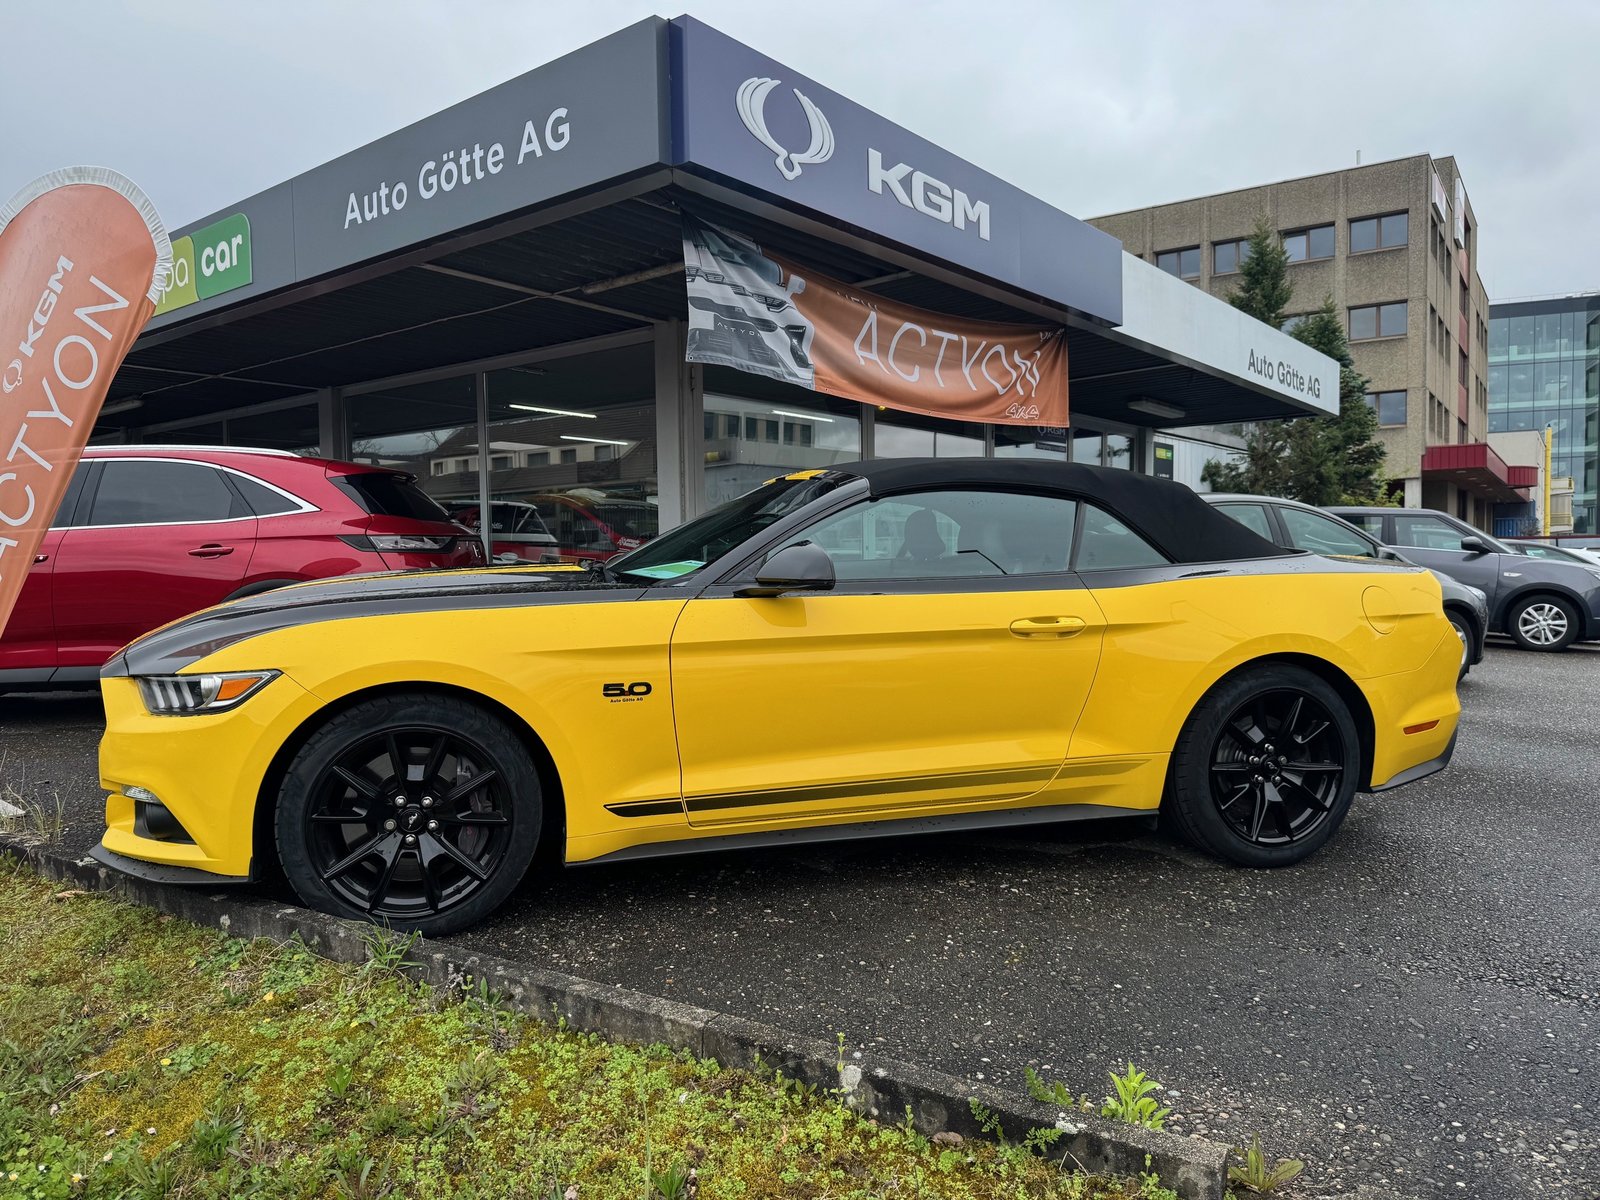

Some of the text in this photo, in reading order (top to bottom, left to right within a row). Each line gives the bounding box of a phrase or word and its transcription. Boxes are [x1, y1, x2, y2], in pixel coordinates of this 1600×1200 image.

[344, 107, 570, 229] Auto Götte AG
[867, 147, 990, 242] KGM
[201, 234, 243, 277] car
[18, 255, 74, 358] KGM
[853, 310, 1041, 398] ACTYON
[1247, 348, 1321, 399] Auto Götte AG
[602, 681, 652, 697] 5.0
